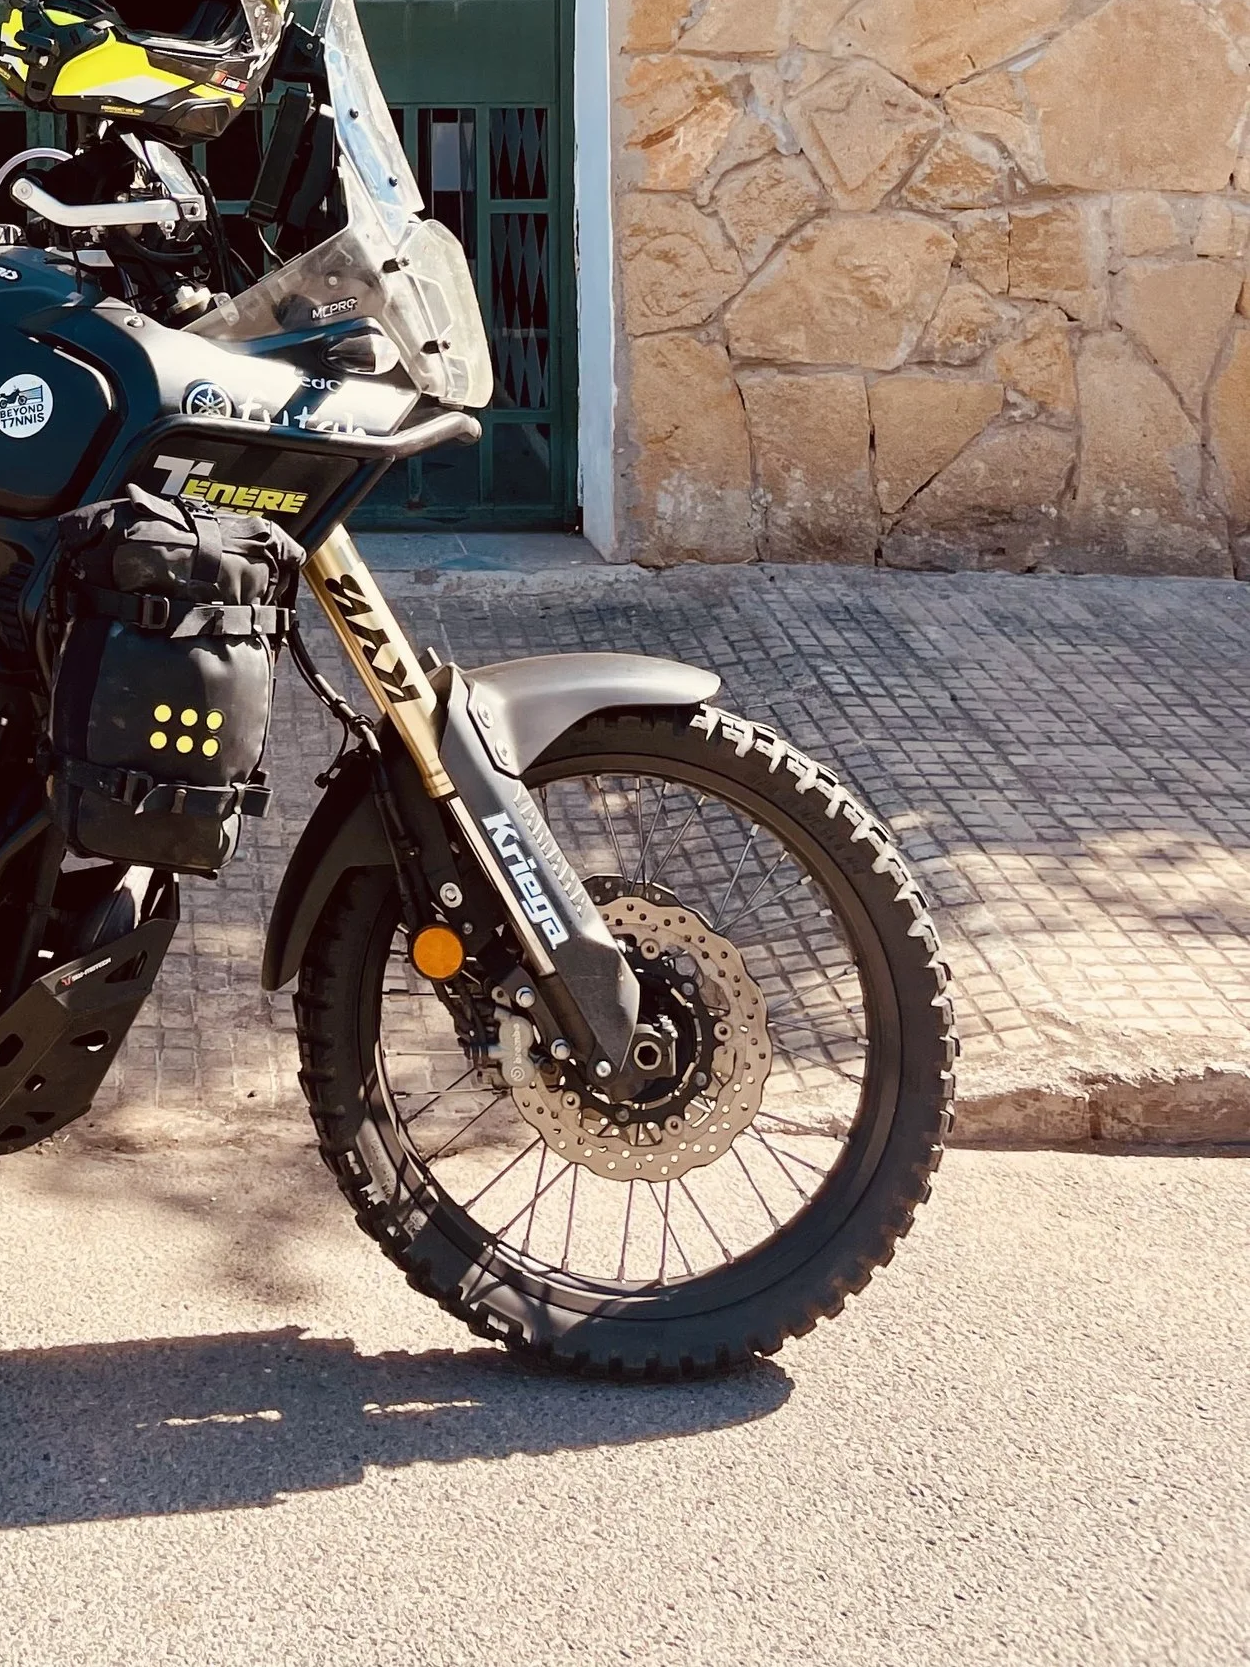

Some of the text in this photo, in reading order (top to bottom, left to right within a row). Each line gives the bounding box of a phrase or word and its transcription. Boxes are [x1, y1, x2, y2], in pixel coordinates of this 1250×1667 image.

[0, 403, 44, 419] BEYOND
[0, 412, 45, 429] T7NNIS
[324, 573, 423, 704] KYB
[481, 810, 570, 951] Kriega
